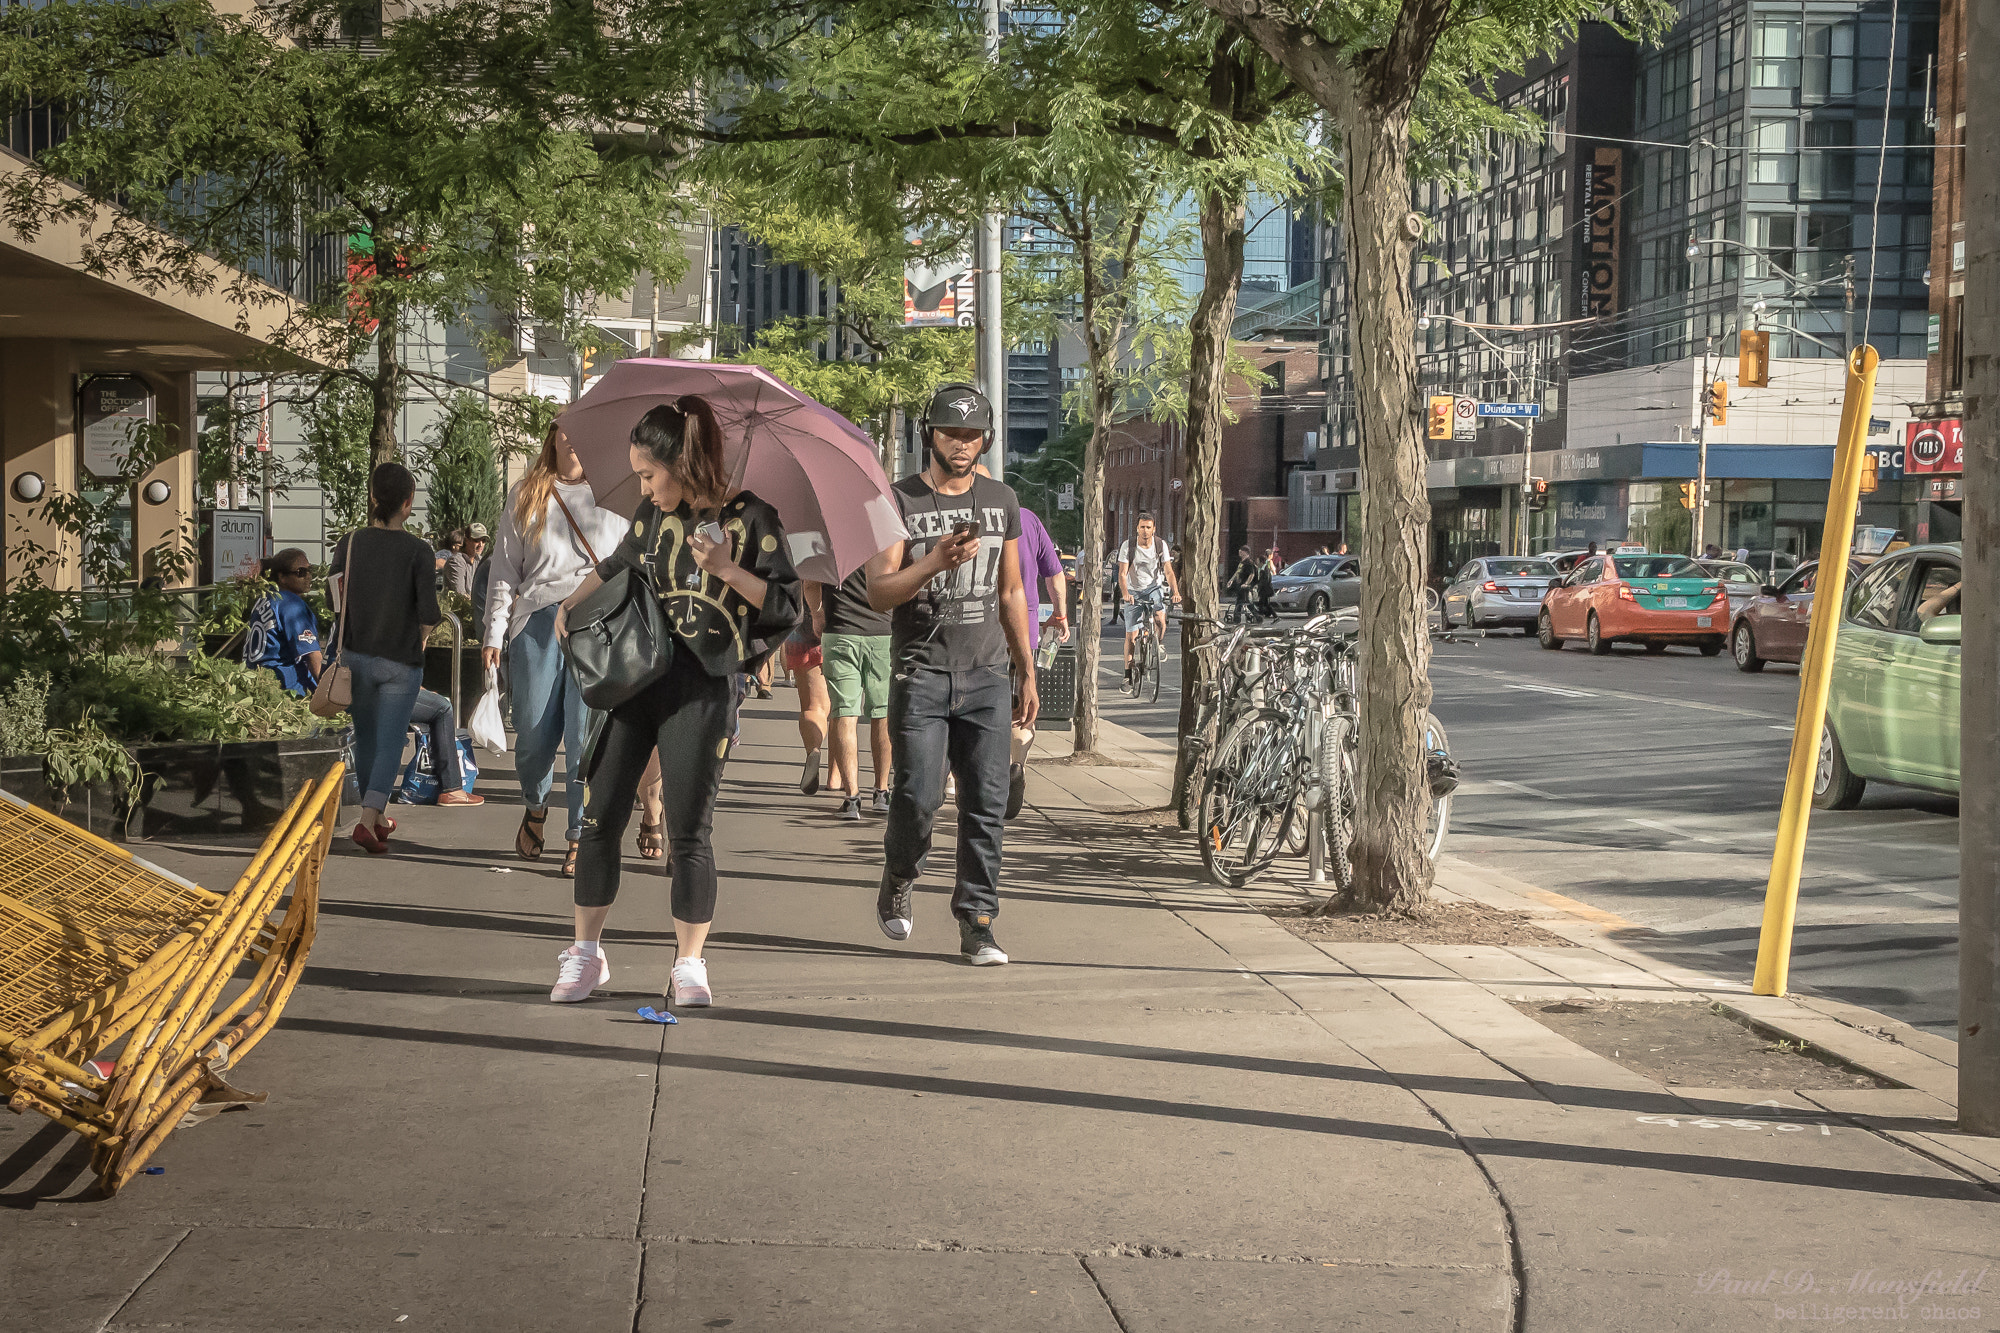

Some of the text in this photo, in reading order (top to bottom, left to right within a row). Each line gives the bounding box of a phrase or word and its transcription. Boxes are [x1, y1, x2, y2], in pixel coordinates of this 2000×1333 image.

[1583, 164, 1592, 244] RENTAL LIVING
[1591, 164, 1615, 319] MOTION
[1581, 270, 1590, 318] CONCERT
[1484, 404, 1517, 414] Dundas
[1525, 405, 1533, 415] W
[1918, 440, 1939, 454] TBBS
[1586, 452, 1600, 469] Bank
[1867, 450, 1903, 468] BC
[221, 518, 254, 533] atrium
[981, 508, 1004, 533] IT
